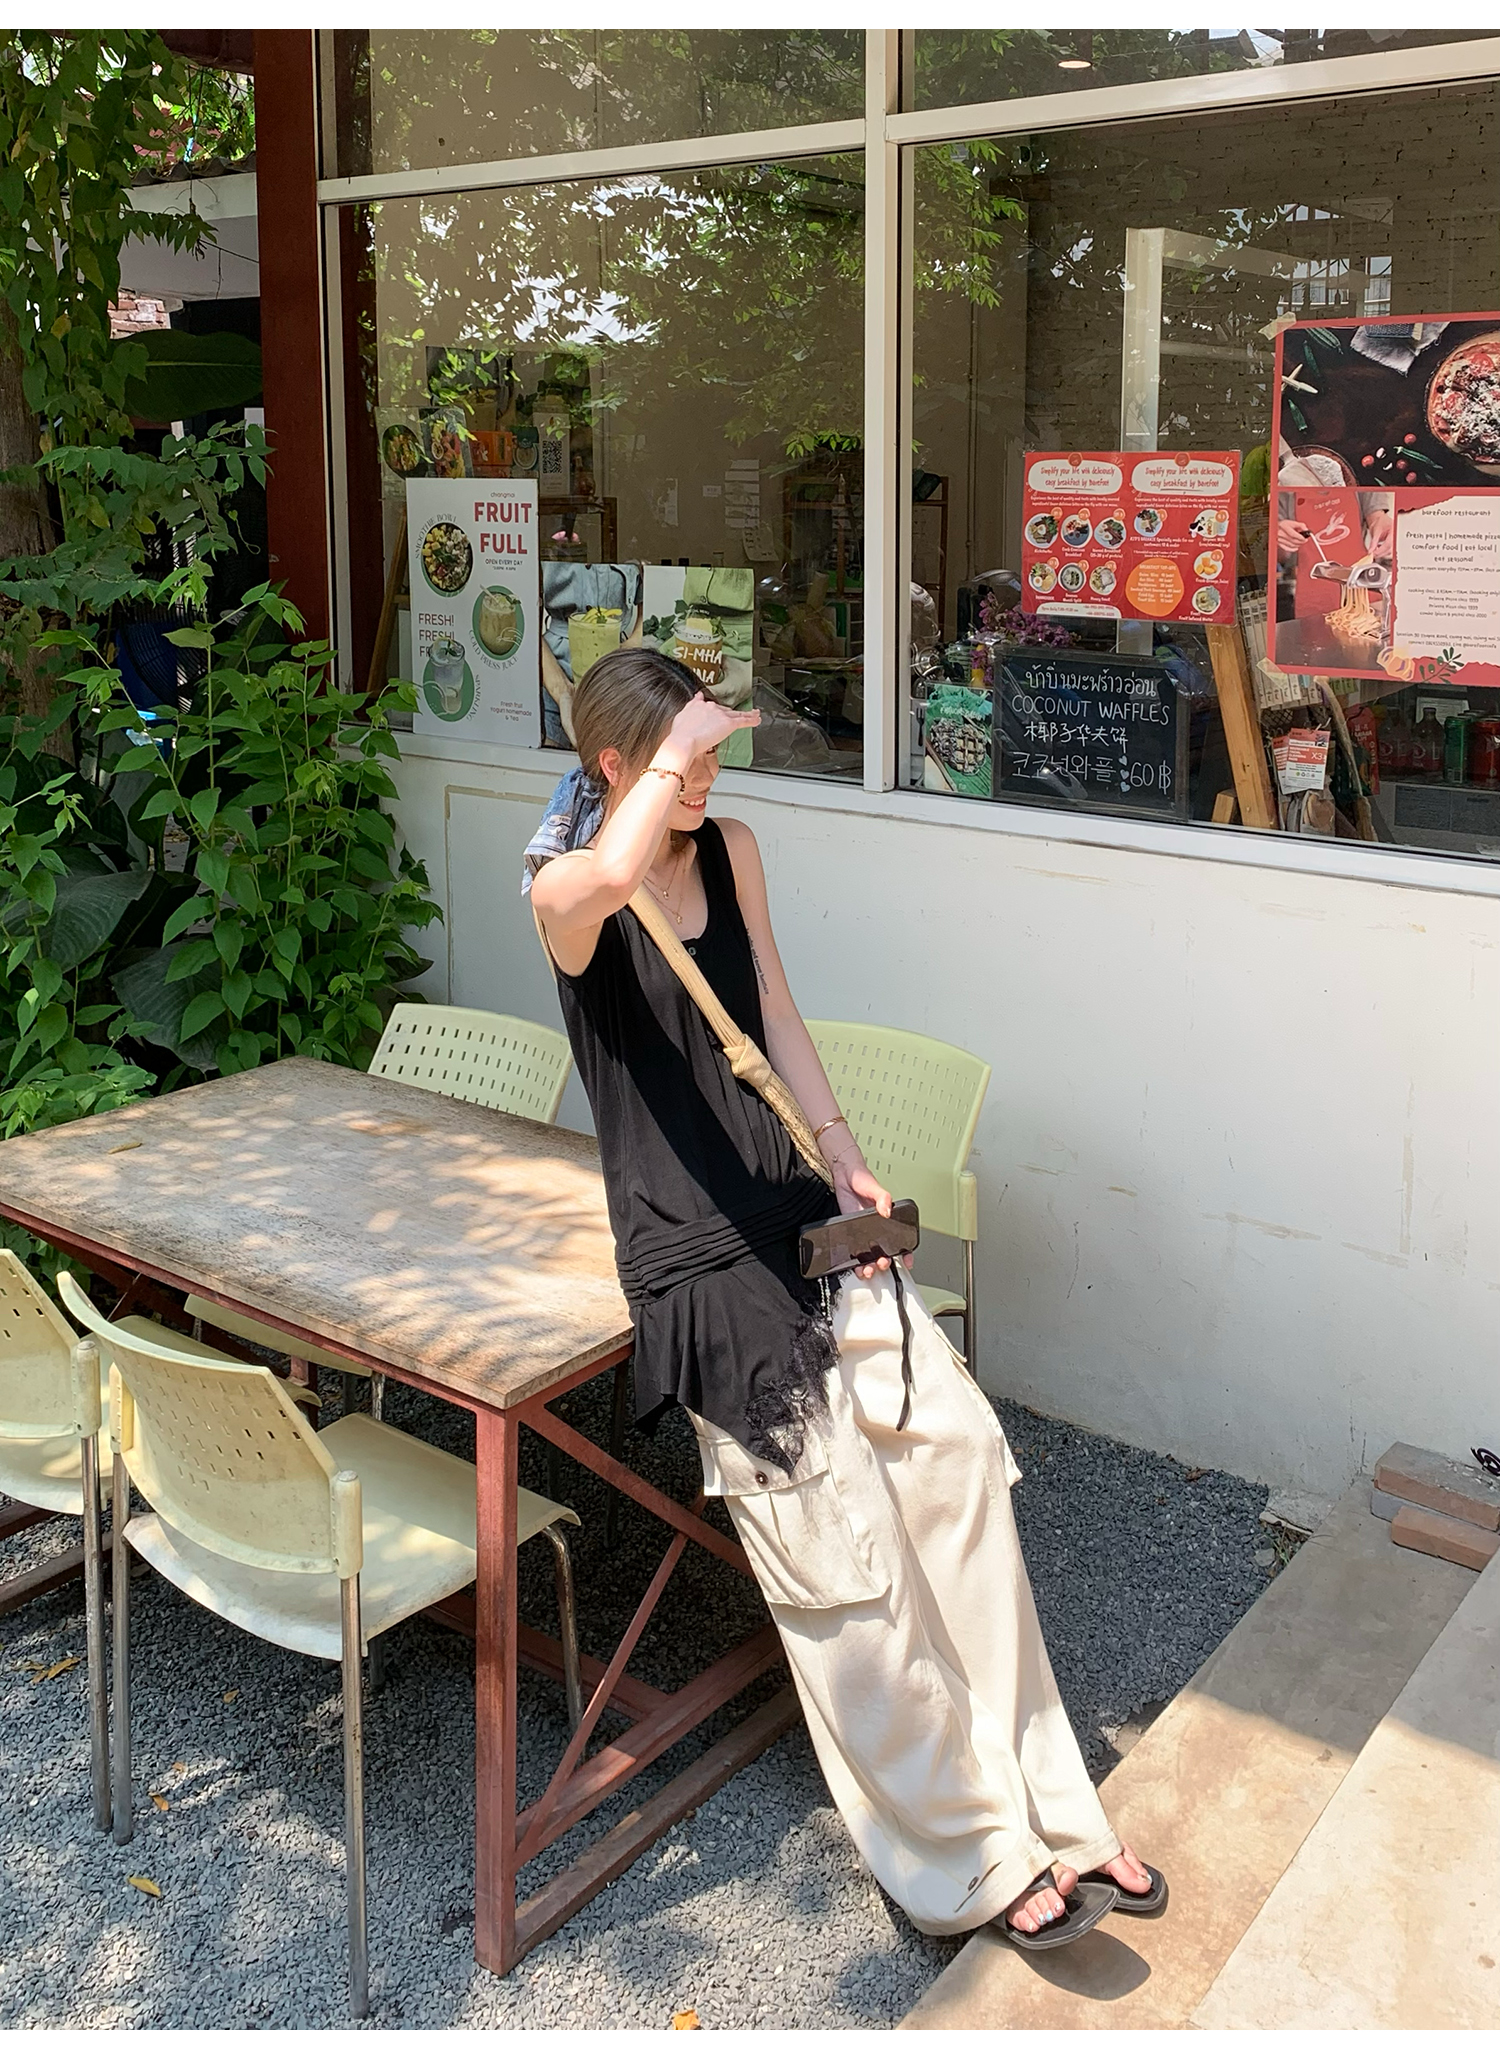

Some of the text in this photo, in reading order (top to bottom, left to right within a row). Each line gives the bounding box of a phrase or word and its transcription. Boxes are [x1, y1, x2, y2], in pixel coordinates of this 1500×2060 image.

[1060, 467, 1070, 476] your
[1166, 468, 1177, 477] your
[1045, 480, 1056, 488] easy
[1057, 478, 1080, 487] breakfast
[1081, 479, 1088, 489] by
[1150, 480, 1162, 489] easy
[1163, 479, 1188, 487] breakfast
[1189, 480, 1196, 489] by
[474, 502, 532, 523] FRUIT
[1406, 531, 1424, 539] fresh
[1448, 532, 1483, 540] homemade
[480, 533, 528, 554] FULL
[1442, 543, 1459, 551] food
[418, 613, 454, 627] FRESH!
[480, 655, 500, 669] PRESS
[502, 656, 518, 671] JUICE
[672, 646, 723, 665] SI-MHA
[1025, 662, 1156, 698] บ้าบิ่นมะพร้าวอ่อน
[505, 708, 532, 717] homemade
[1012, 695, 1092, 717] COCONUT
[1098, 701, 1170, 726] WAFFLES
[1023, 721, 1128, 754] 椰子华夫饼
[1012, 751, 1116, 783] 코코넛와플
